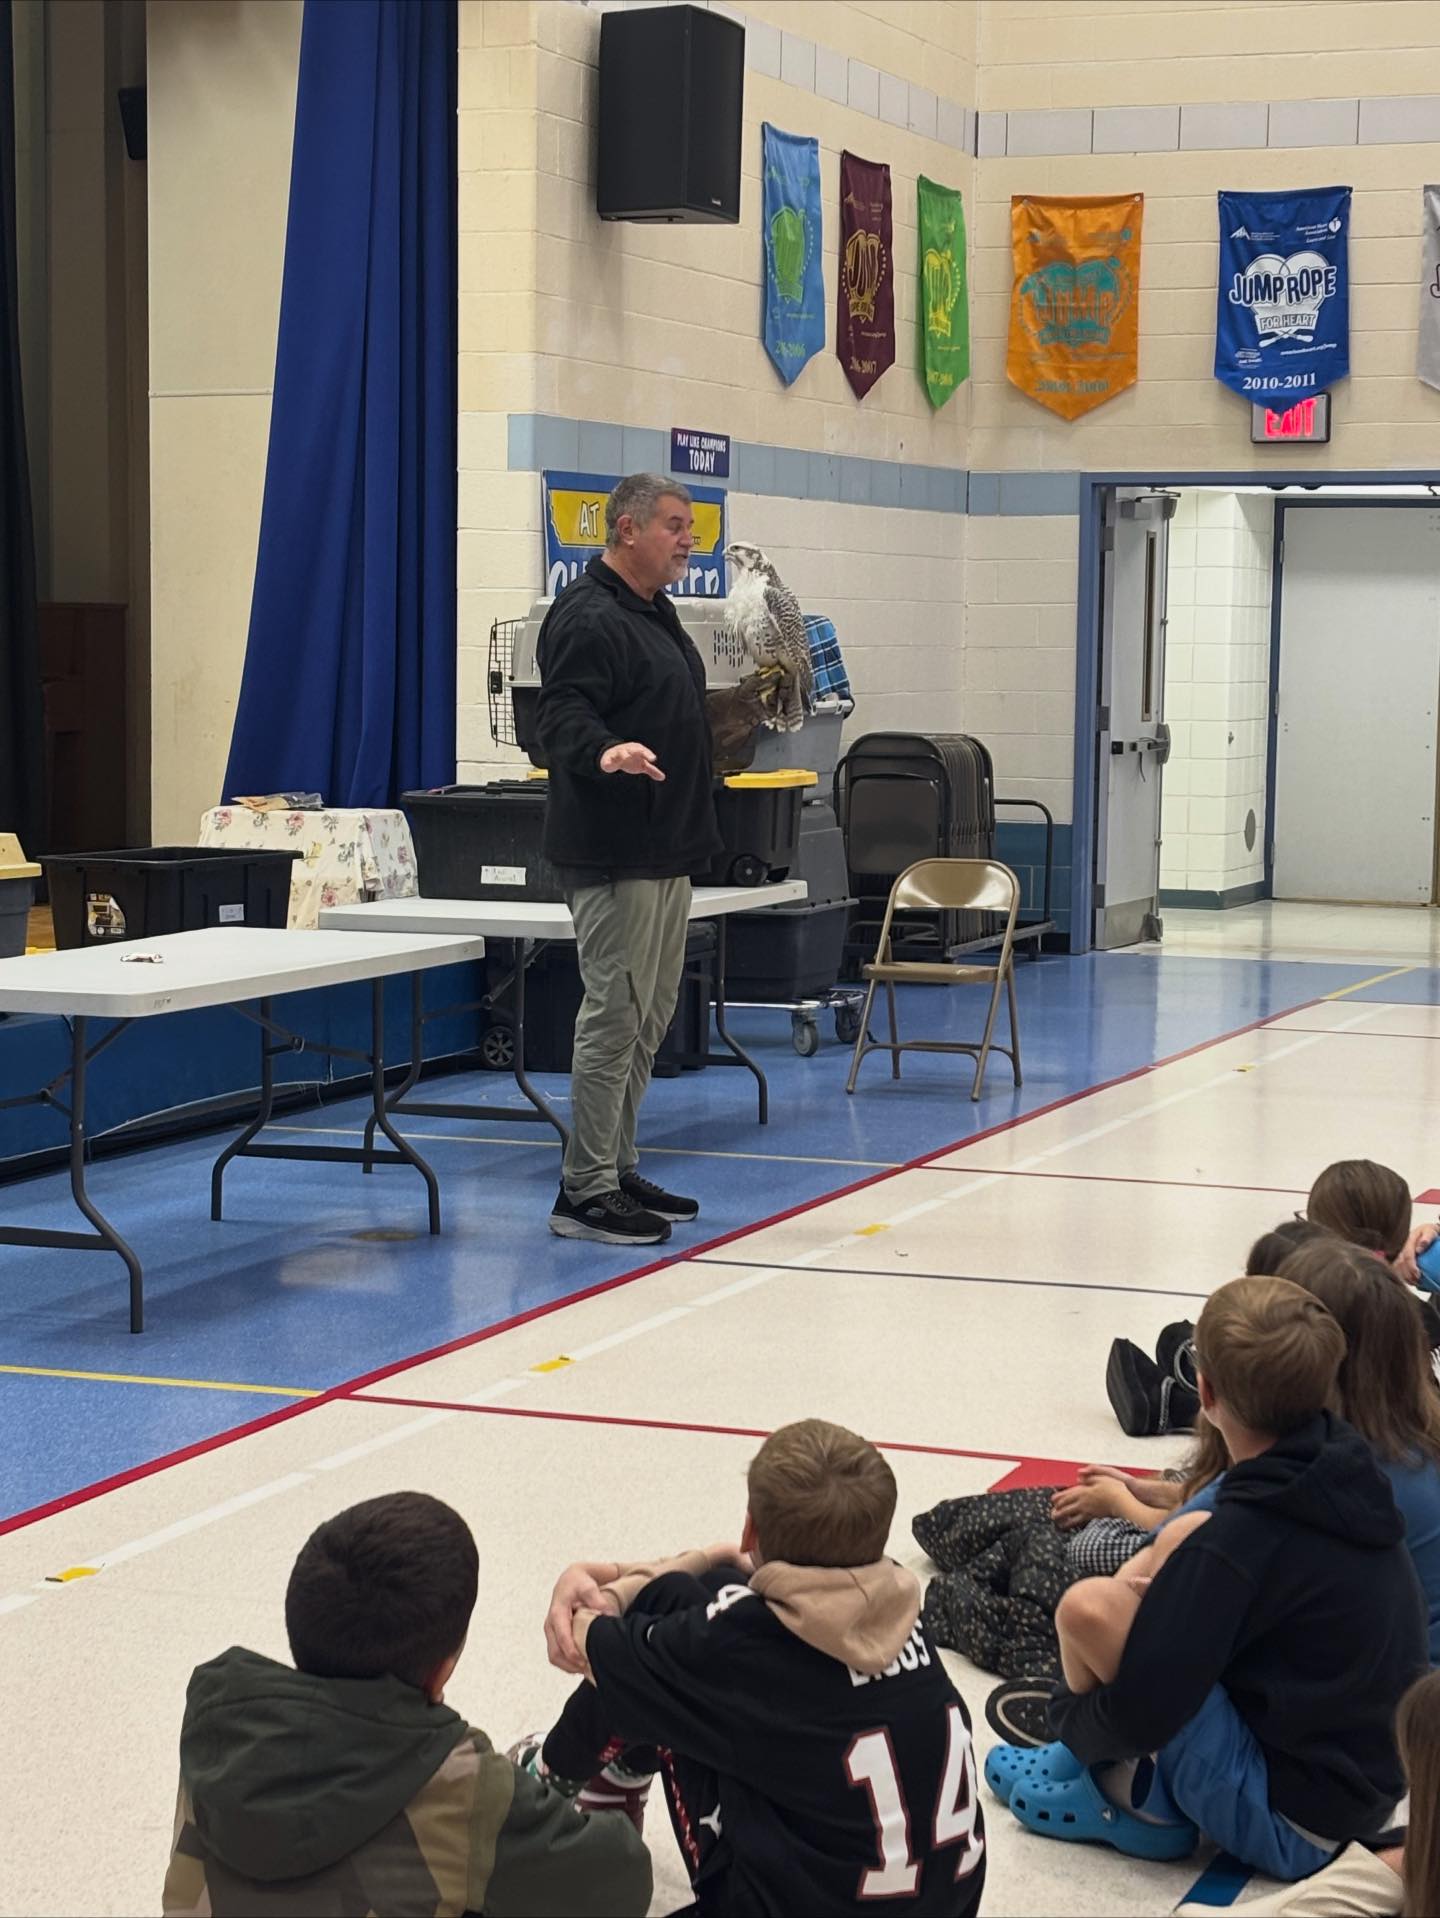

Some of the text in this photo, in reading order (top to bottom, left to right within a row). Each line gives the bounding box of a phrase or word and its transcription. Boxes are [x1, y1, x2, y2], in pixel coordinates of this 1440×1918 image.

[1229, 266, 1337, 307] JUMP ROPE
[1260, 313, 1316, 330] FOR HEART
[1242, 372, 1316, 390] 2010-2011
[677, 433, 689, 447] PLAY
[689, 435, 700, 449] LIKE
[689, 449, 715, 473] TODAY
[579, 500, 600, 537] AT
[843, 1703, 985, 1900] 14
